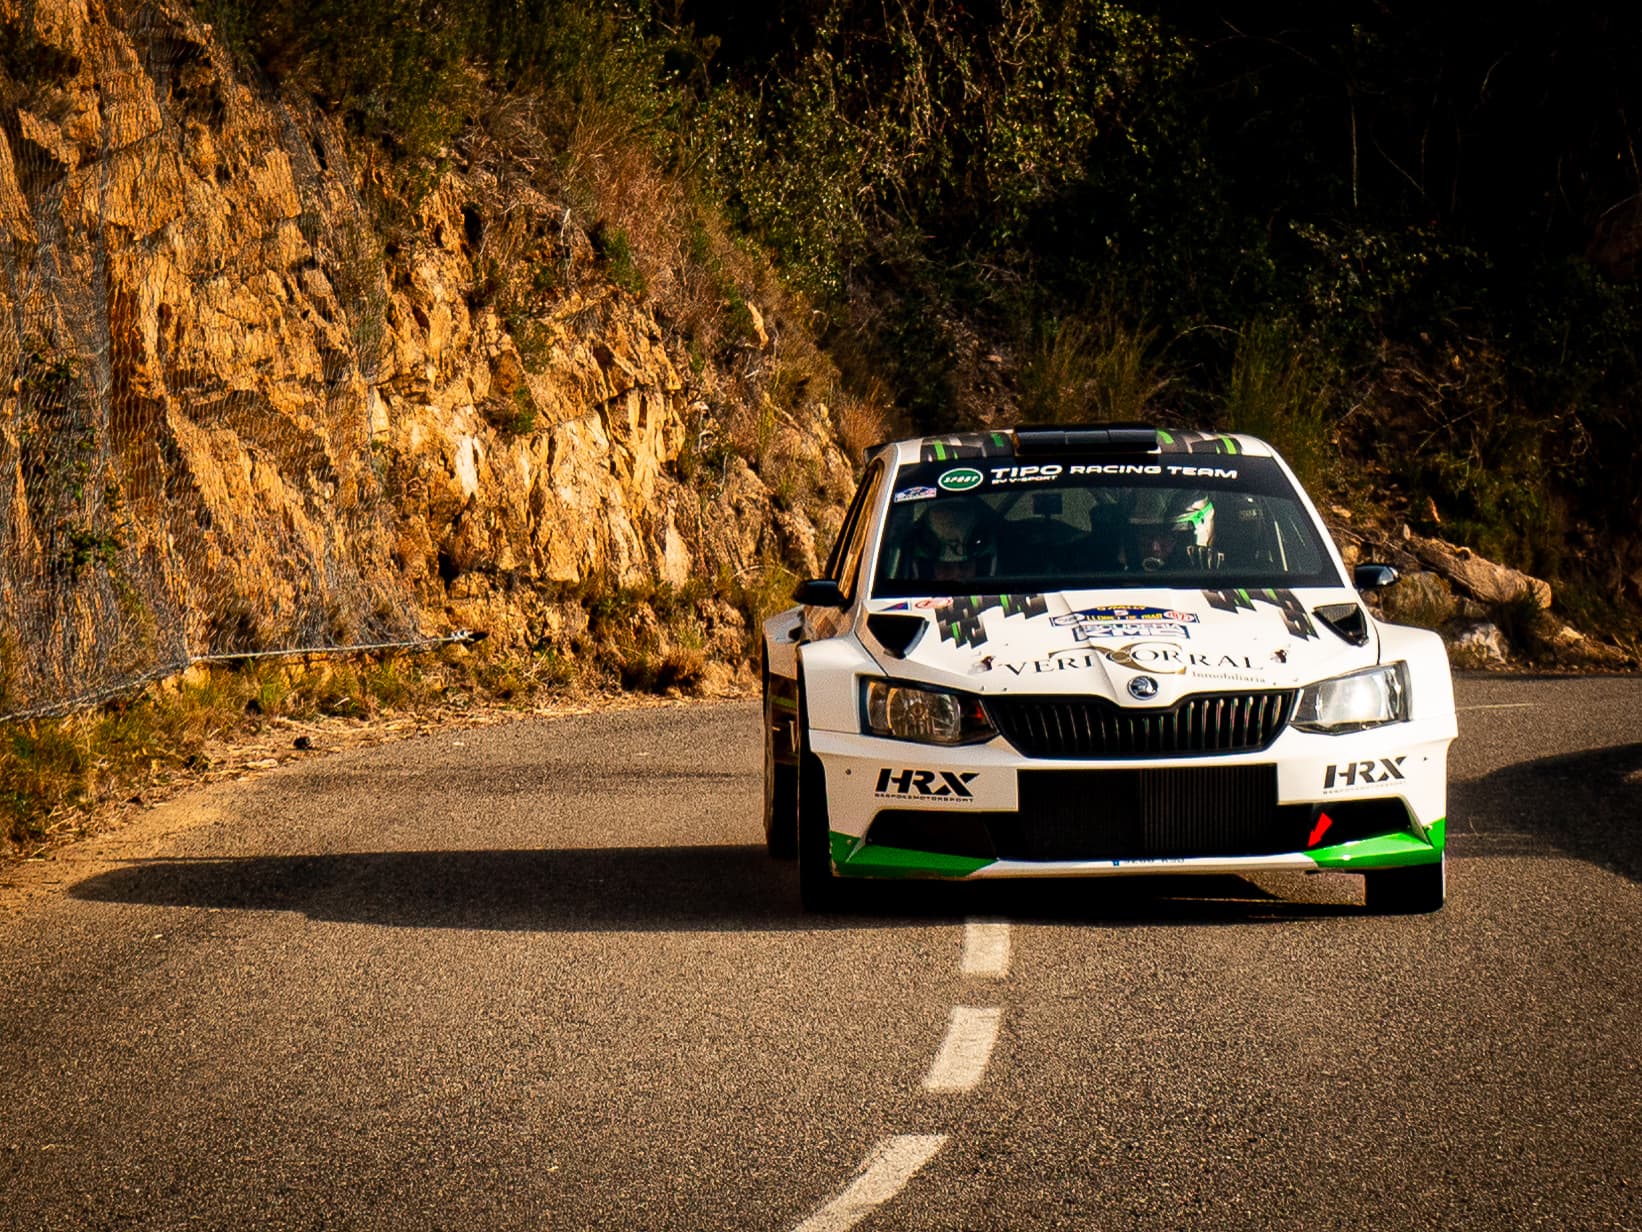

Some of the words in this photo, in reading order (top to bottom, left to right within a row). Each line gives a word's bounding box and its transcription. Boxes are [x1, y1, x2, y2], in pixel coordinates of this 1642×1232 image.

[991, 465, 1063, 479] TIPO
[1069, 464, 1162, 475] RACING
[1167, 466, 1238, 479] TEAM
[875, 768, 980, 797] HRX
[1323, 756, 1407, 789] HRX
